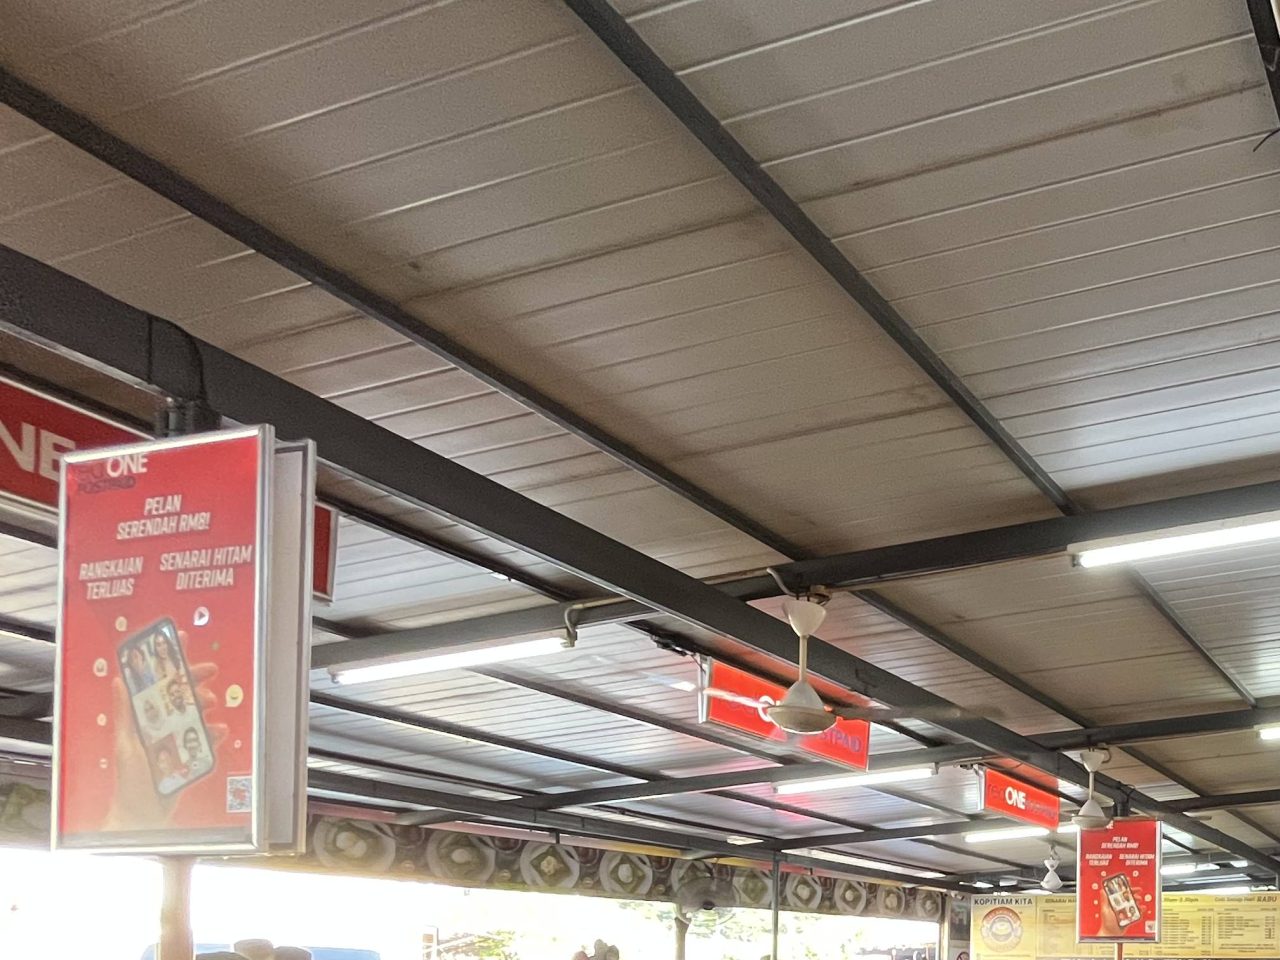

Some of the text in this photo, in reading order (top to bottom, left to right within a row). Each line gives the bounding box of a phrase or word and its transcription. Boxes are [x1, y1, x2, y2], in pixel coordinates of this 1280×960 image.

[143, 494, 182, 516] PELAN
[116, 515, 177, 540] SERENDAH
[78, 556, 144, 581] RANGKAIAN
[159, 545, 253, 571] SENARAI HITAM
[86, 578, 135, 600] TERLUAS
[176, 567, 234, 591] DITERIMA
[974, 898, 1013, 906] KOPITIAM
